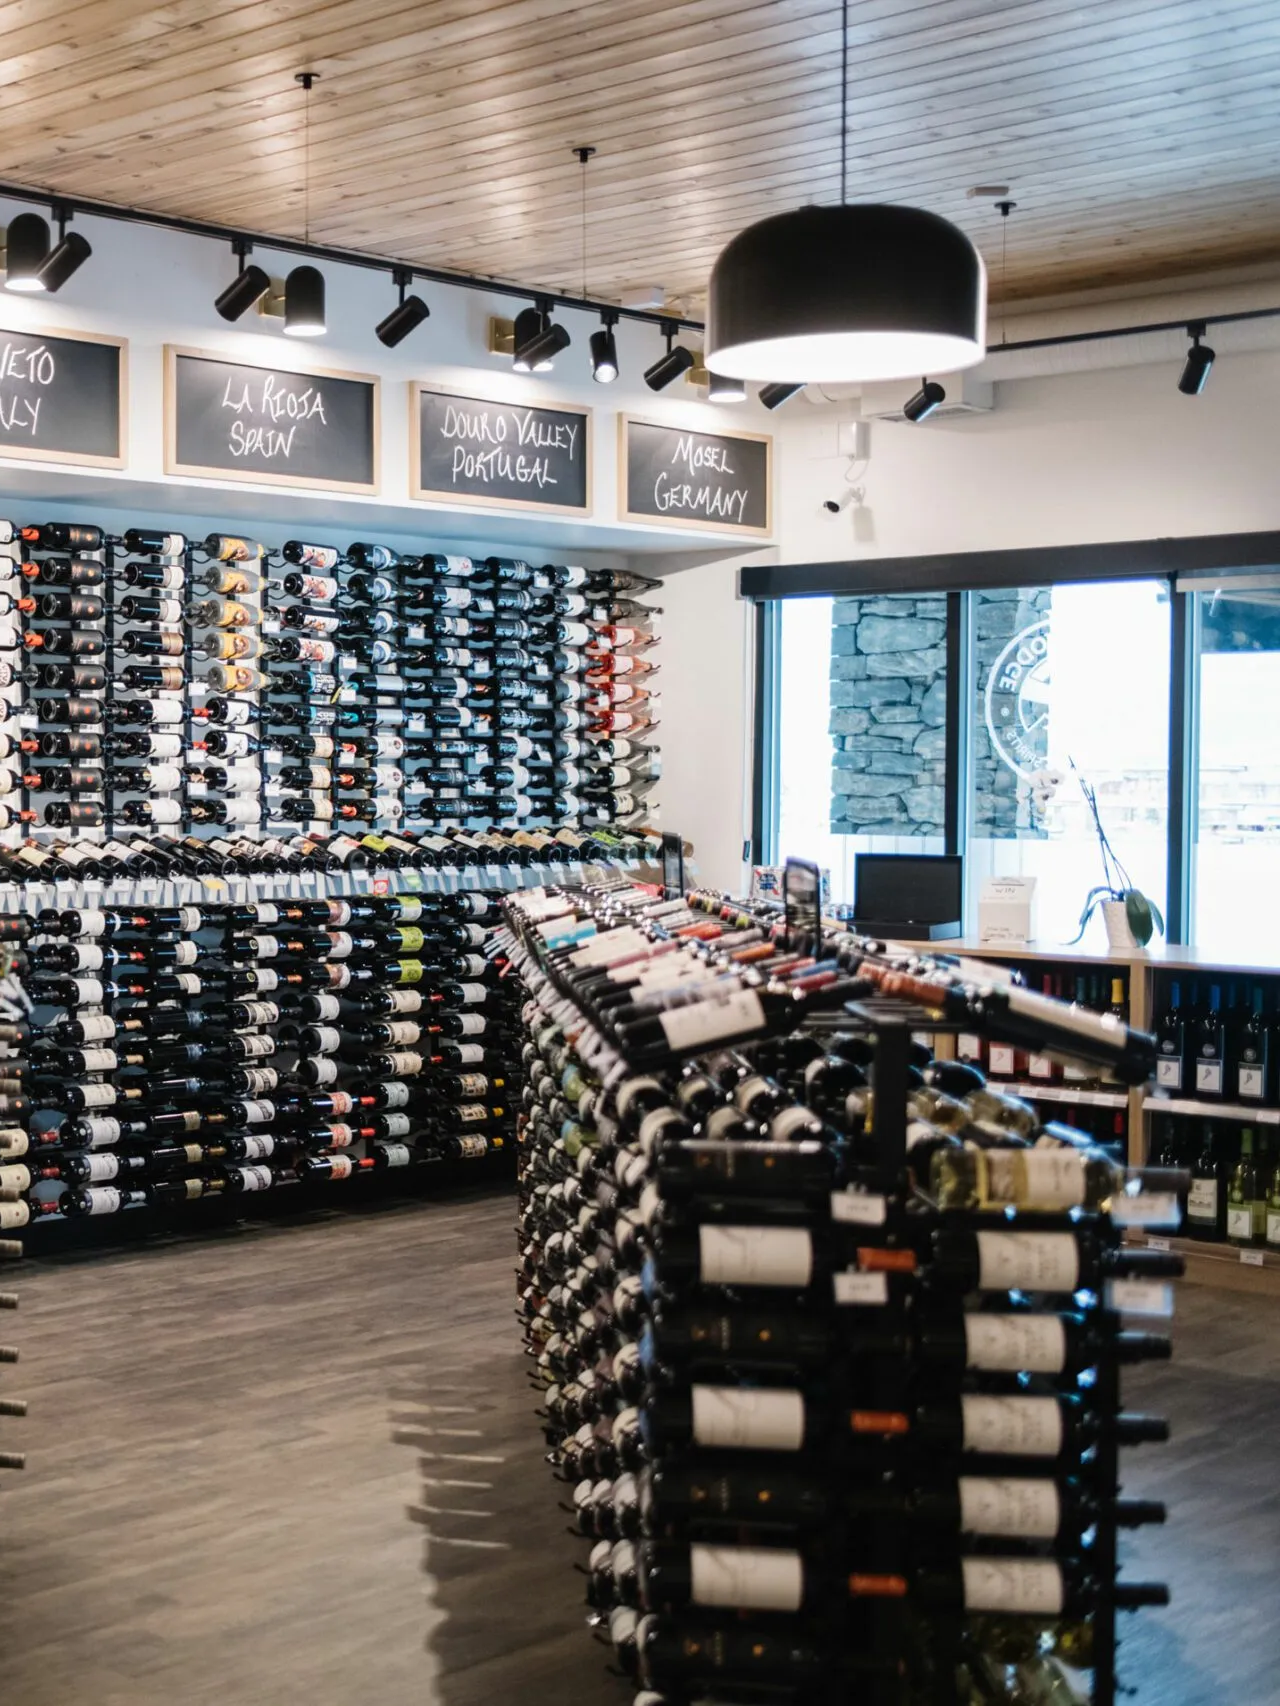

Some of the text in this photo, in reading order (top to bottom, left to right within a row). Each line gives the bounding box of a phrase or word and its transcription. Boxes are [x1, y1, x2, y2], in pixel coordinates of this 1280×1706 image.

[222, 374, 327, 425] LA RIOJA
[228, 420, 297, 459] SPAIN
[440, 405, 578, 461] DOURO VALLEY
[671, 434, 735, 477] MOSEL
[452, 445, 558, 489] PORTUGAL
[654, 471, 748, 524] GERMANY
